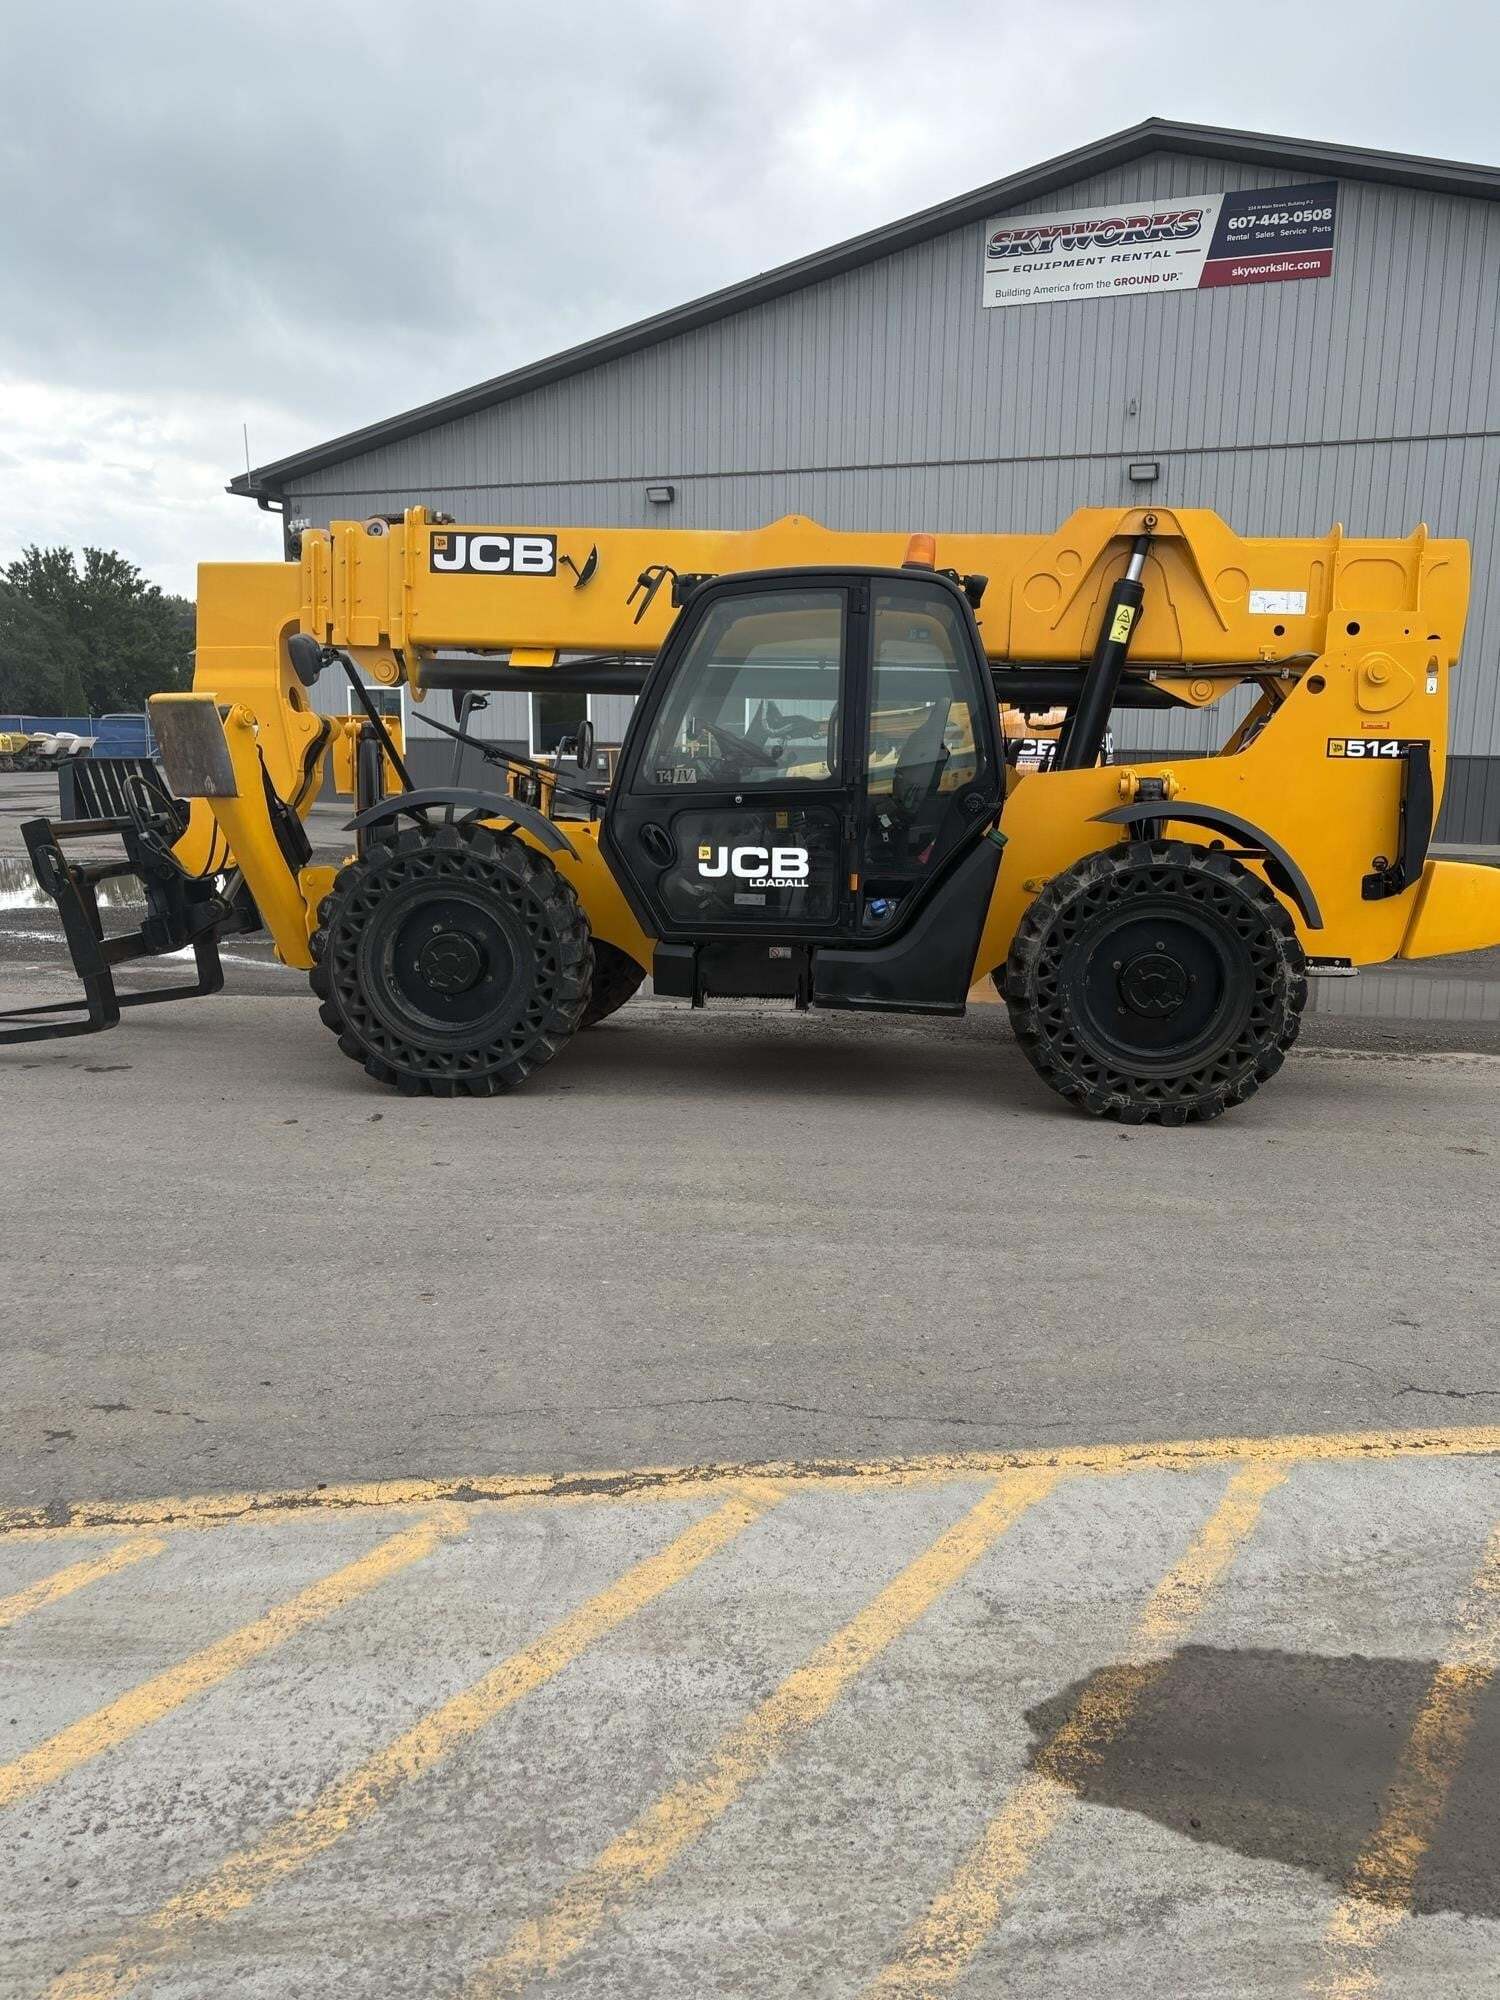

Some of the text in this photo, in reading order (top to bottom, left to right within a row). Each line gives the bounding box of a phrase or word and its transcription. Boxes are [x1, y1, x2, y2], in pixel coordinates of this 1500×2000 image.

[1228, 208, 1332, 229] 607-442-0508
[987, 208, 1203, 259] SKYWORKS
[1226, 225, 1332, 242] Rental Sales Service Parts
[1013, 249, 1172, 273] EQUIPMENT RENTAL
[1231, 260, 1321, 277] skyworksllc.com
[995, 287, 1031, 298] Building
[1033, 284, 1070, 295] America
[1073, 281, 1094, 291] from
[1096, 279, 1111, 288] the
[1113, 274, 1160, 287] GROUND
[433, 535, 554, 572] JCB
[698, 845, 810, 878] JCB
[749, 878, 809, 888] LOADALL
